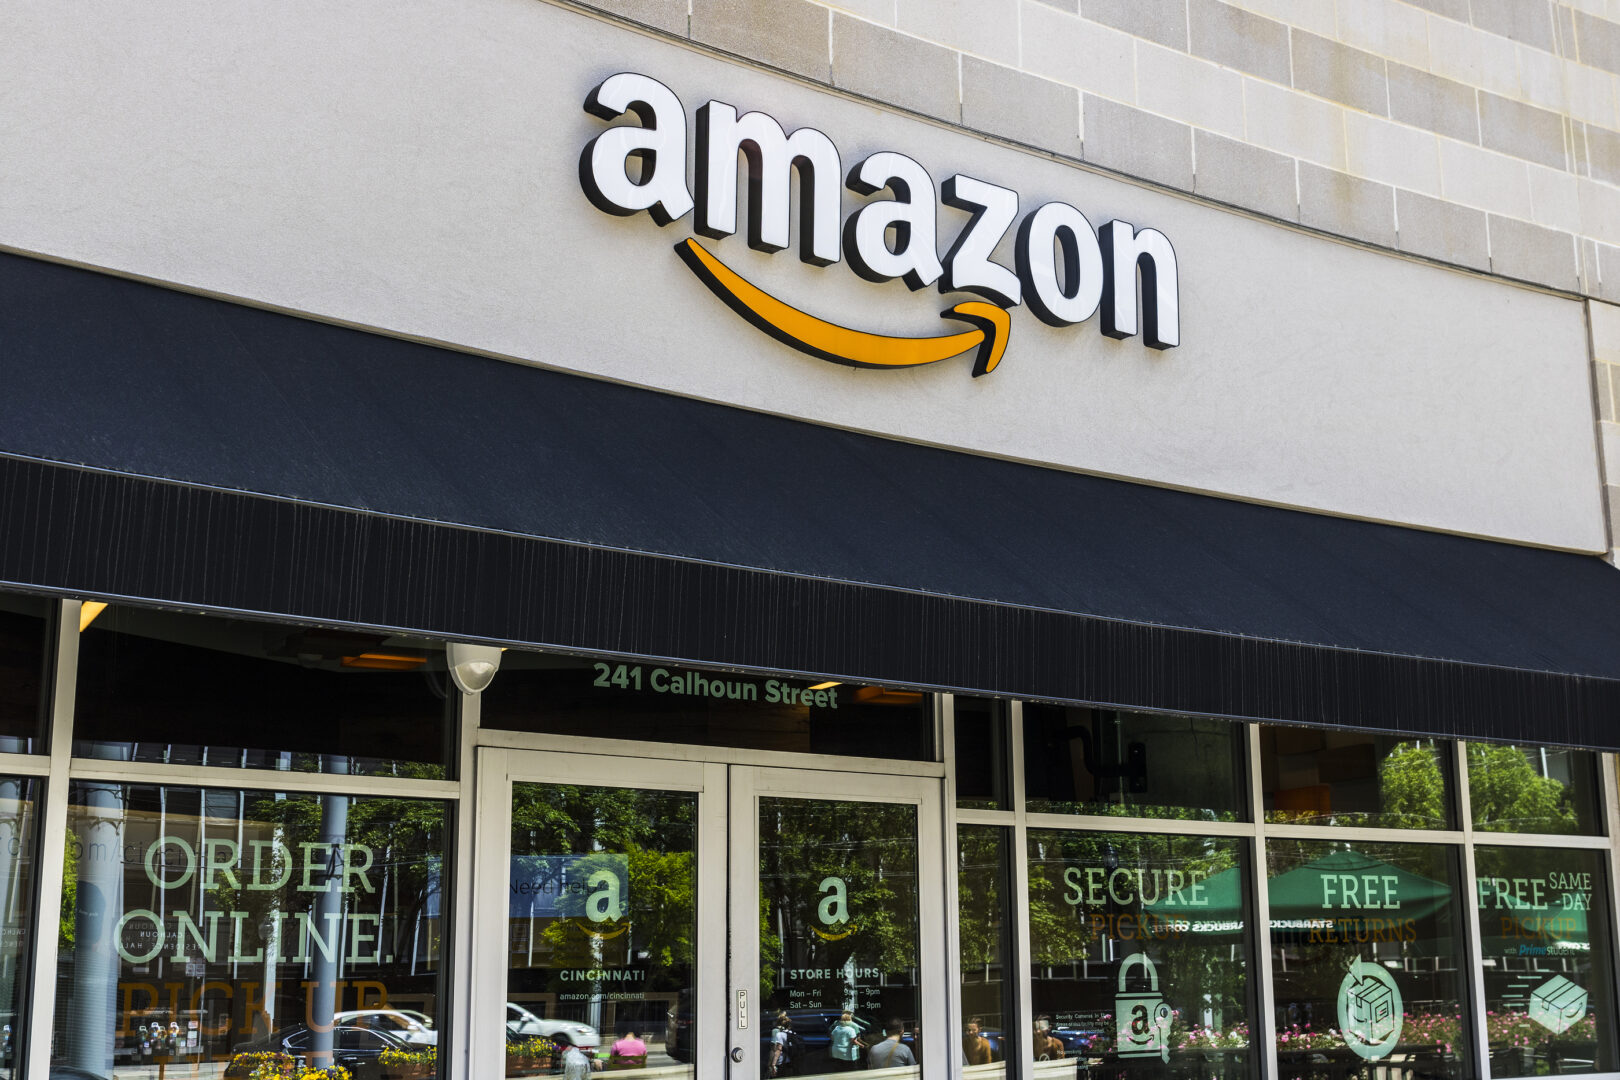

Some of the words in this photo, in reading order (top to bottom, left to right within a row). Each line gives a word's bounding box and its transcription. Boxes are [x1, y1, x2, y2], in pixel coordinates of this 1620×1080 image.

[579, 72, 1180, 350] amazon
[593, 662, 642, 691] 241
[650, 668, 757, 701] Calhoun
[765, 680, 838, 709] Street
[144, 836, 376, 894] ORDER
[585, 870, 622, 923] a
[817, 876, 851, 925] a
[1063, 866, 1209, 906] SECURE
[1320, 874, 1401, 909] FREE
[1476, 877, 1548, 910] FREE
[1549, 872, 1593, 890] SAME
[113, 908, 393, 964] ONLINE.
[1089, 913, 1187, 942] PICKUP
[1308, 917, 1417, 944] RETURNS
[1500, 917, 1577, 939] PICKUP
[560, 969, 645, 982] CINCINNATI
[789, 968, 831, 980] STORE
[836, 967, 880, 979] HOURS
[115, 981, 281, 1038] PICK
[790, 989, 805, 998] Mon
[812, 988, 822, 997] Fri
[865, 987, 881, 997] 9pm
[790, 1001, 801, 1009] Sat
[809, 1001, 822, 1009] Sun
[866, 1001, 881, 1011] 9pm
[1131, 1004, 1150, 1035] a
